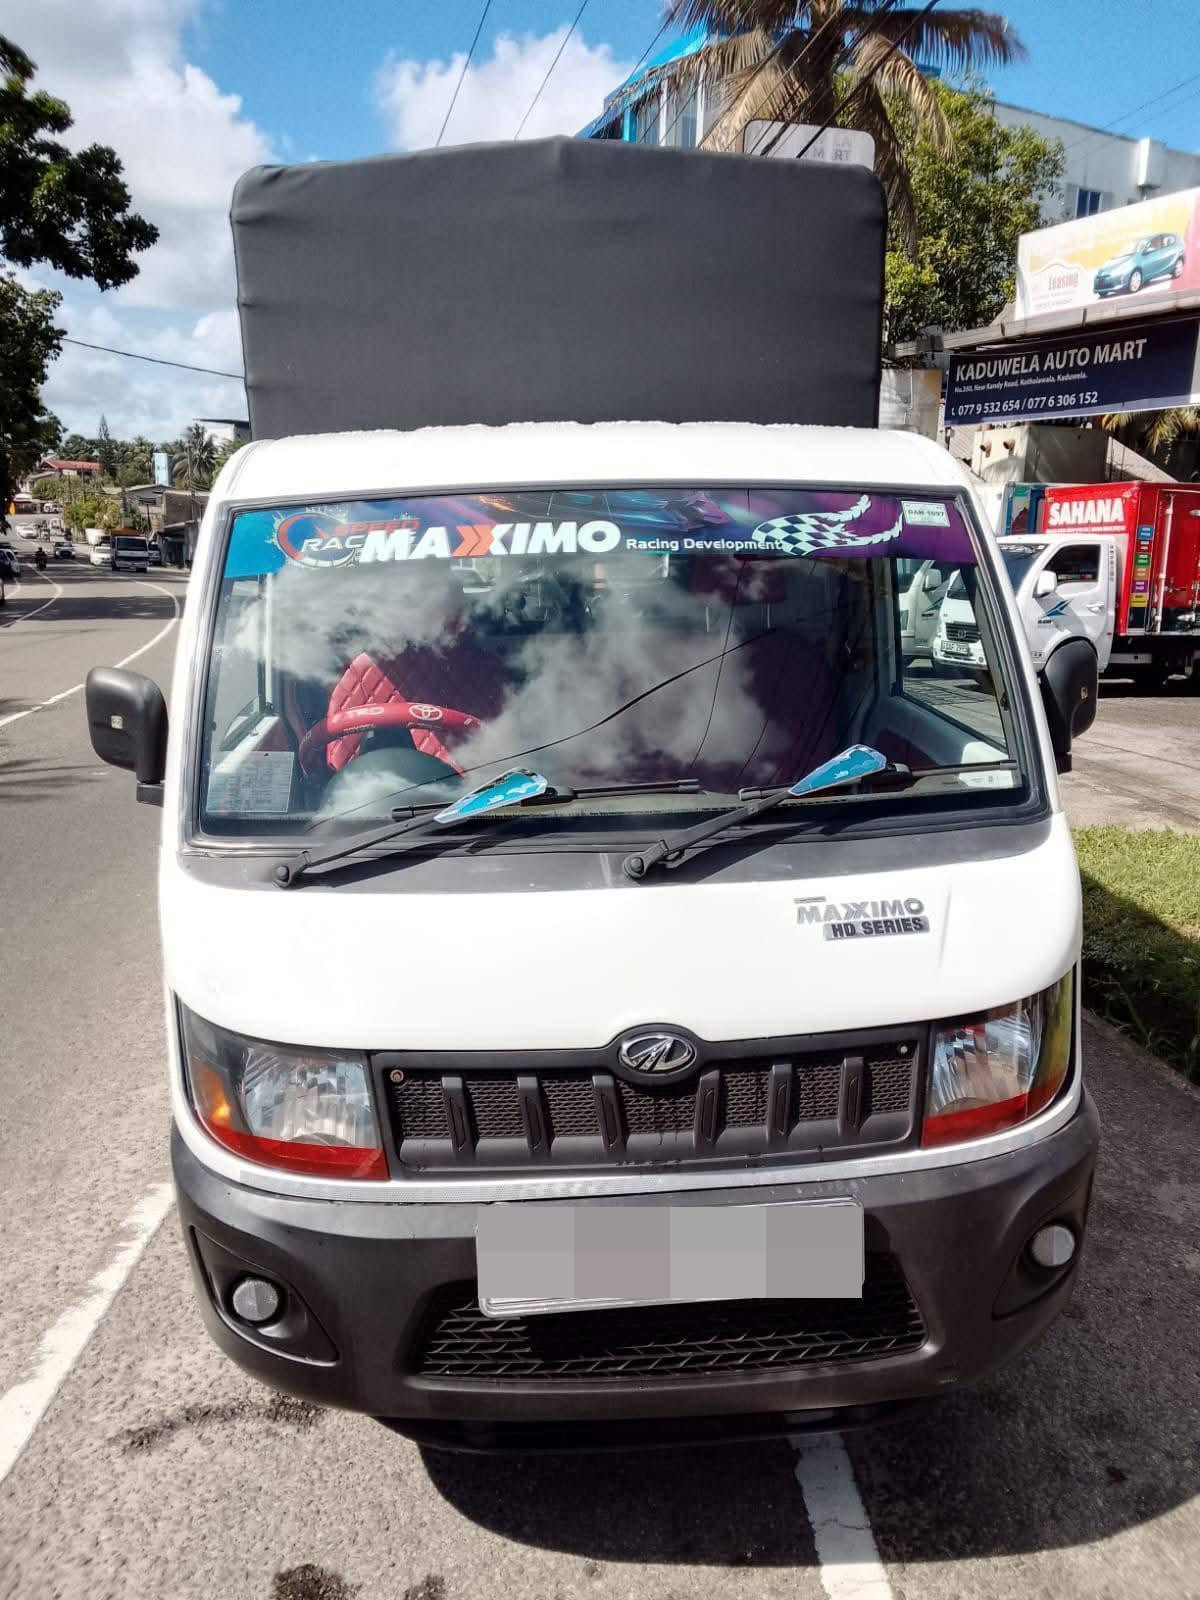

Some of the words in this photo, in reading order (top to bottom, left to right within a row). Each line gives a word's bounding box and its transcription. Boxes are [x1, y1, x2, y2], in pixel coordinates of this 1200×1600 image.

[956, 356, 1040, 382] KADUWELA
[1043, 347, 1090, 371] AUTO
[1093, 339, 1147, 365] MART
[958, 405, 975, 417] 077
[976, 403, 982, 415] 9
[983, 402, 1001, 414] 532
[1002, 399, 1021, 412] 654
[1027, 396, 1047, 409] 077
[1048, 395, 1055, 407] 6
[1057, 393, 1077, 407] 306
[1079, 391, 1099, 404] 152
[1048, 497, 1125, 526] SAHANA
[626, 538, 680, 552] Racing
[684, 538, 784, 552] Development
[832, 922, 857, 938] HD
[861, 916, 924, 936] SERIES
